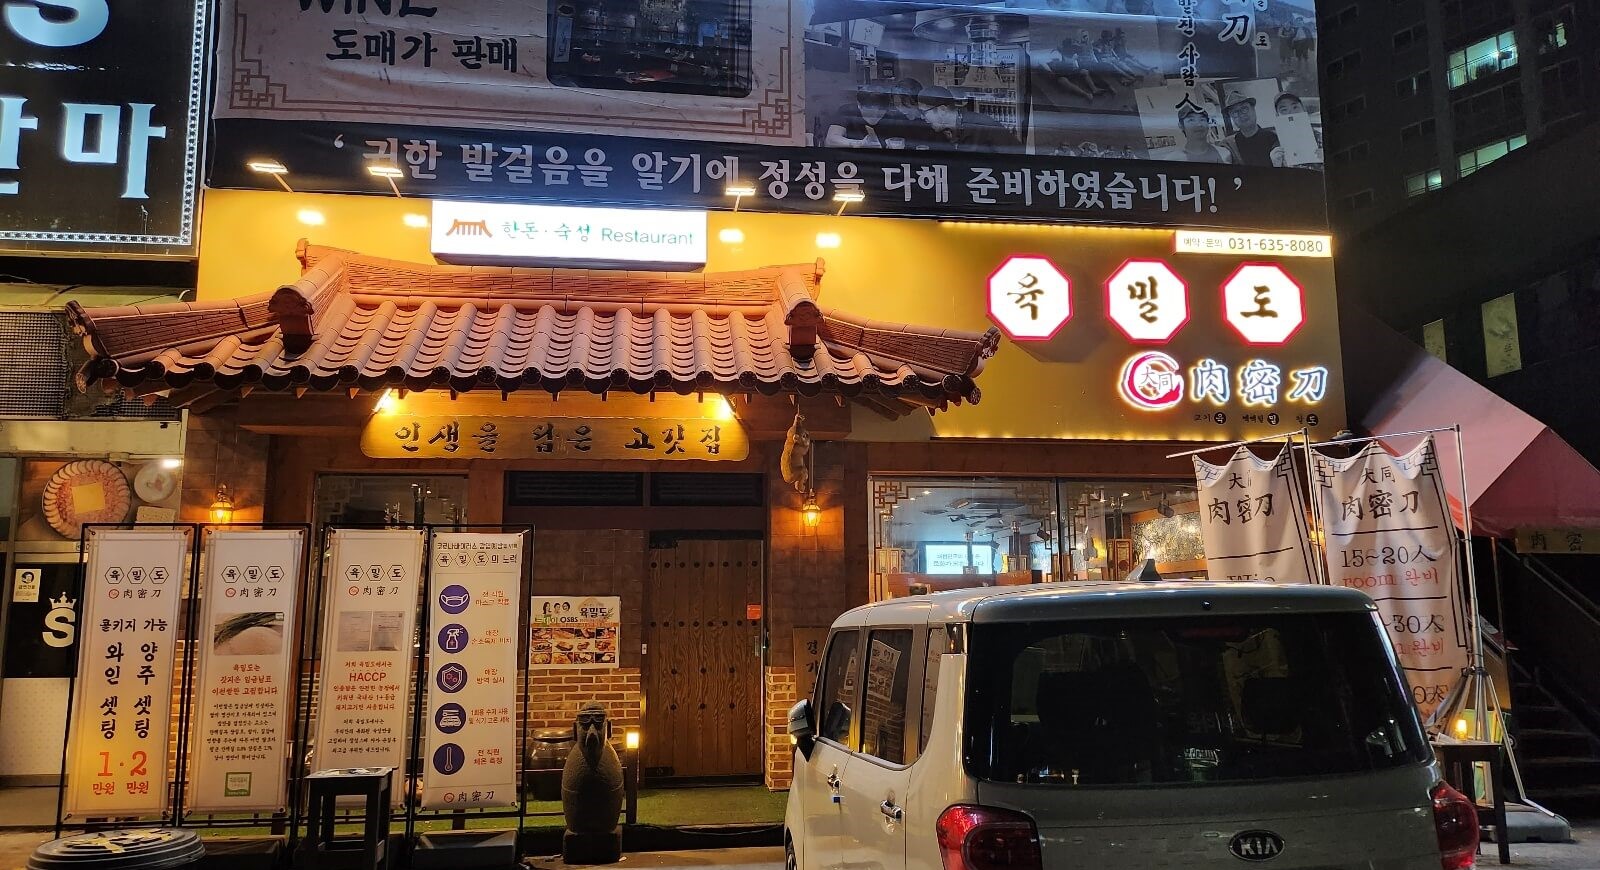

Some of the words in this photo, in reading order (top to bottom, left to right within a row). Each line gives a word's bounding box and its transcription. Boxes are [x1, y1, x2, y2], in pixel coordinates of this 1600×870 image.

[326, 29, 438, 68] 도매가
[451, 36, 518, 73] 판매
[1178, 43, 1200, 87] 사람
[363, 138, 442, 180] 귀한
[460, 143, 613, 188] 발걸음을
[632, 150, 739, 193] 알기에
[758, 160, 865, 200] 정성을
[882, 163, 949, 203] 다해
[966, 166, 1217, 213] 준비하였습니다!
[601, 227, 694, 245] Restaurant
[1228, 237, 1323, 252] 031-635-8080
[394, 420, 502, 453] 인생을
[1361, 465, 1396, 485] 大同
[1341, 490, 1419, 521] 肉密刀
[1342, 573, 1398, 588] room
[1404, 567, 1439, 587] 완비
[42, 607, 75, 648] S
[143, 619, 168, 632] 가능
[105, 642, 124, 685] 와인
[137, 642, 158, 685] 양주
[349, 672, 386, 681] HACCP
[100, 695, 118, 739] 셋팅
[134, 695, 151, 738] 셋팅
[93, 782, 115, 795] 만원
[127, 781, 149, 794] 만원
[1239, 837, 1279, 856] KIA
